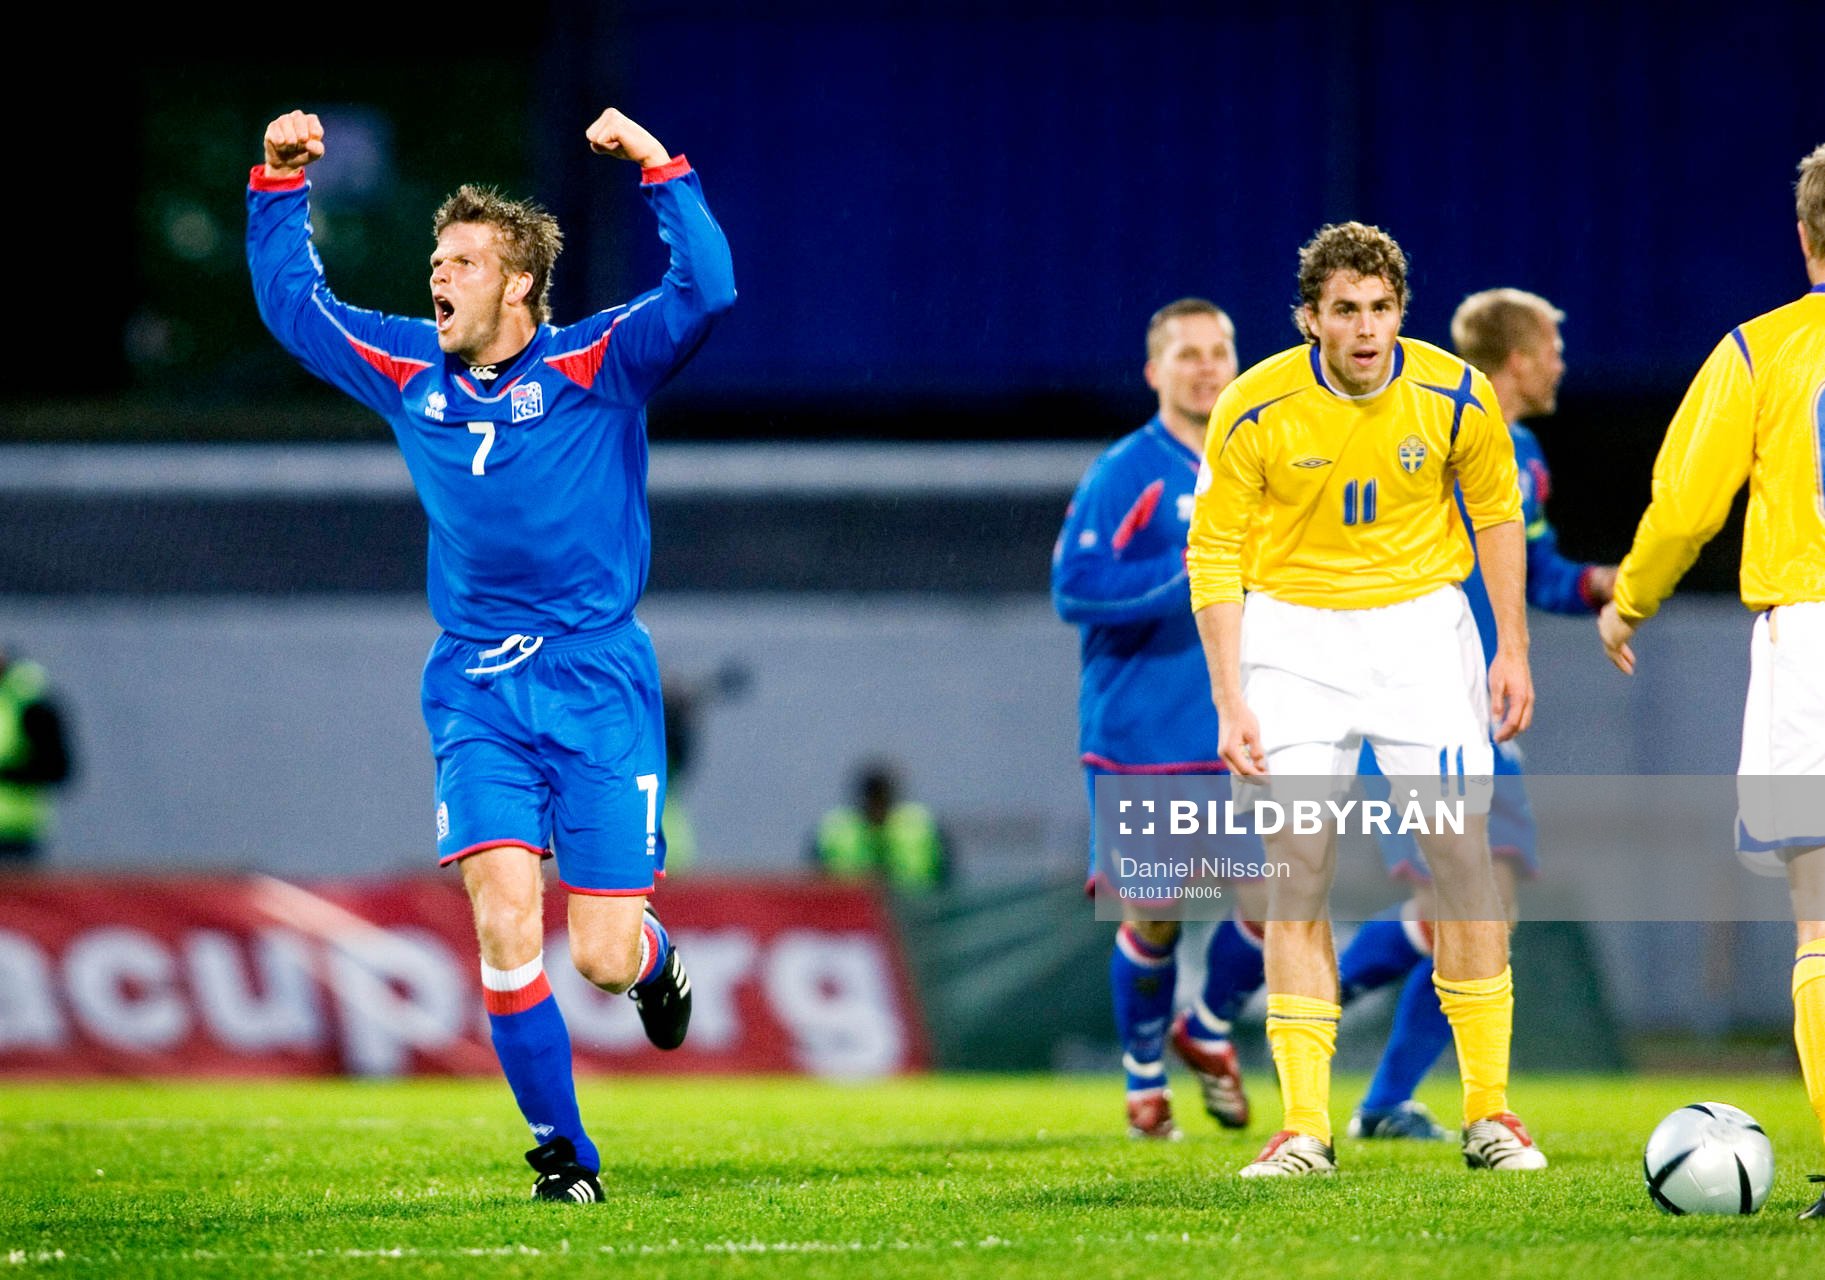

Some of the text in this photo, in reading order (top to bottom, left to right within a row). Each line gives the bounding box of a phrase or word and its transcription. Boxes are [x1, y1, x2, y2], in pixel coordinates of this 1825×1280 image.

[467, 421, 496, 476] 7
[1343, 478, 1376, 525] 11
[1439, 744, 1466, 798] 11
[636, 773, 659, 834] 7
